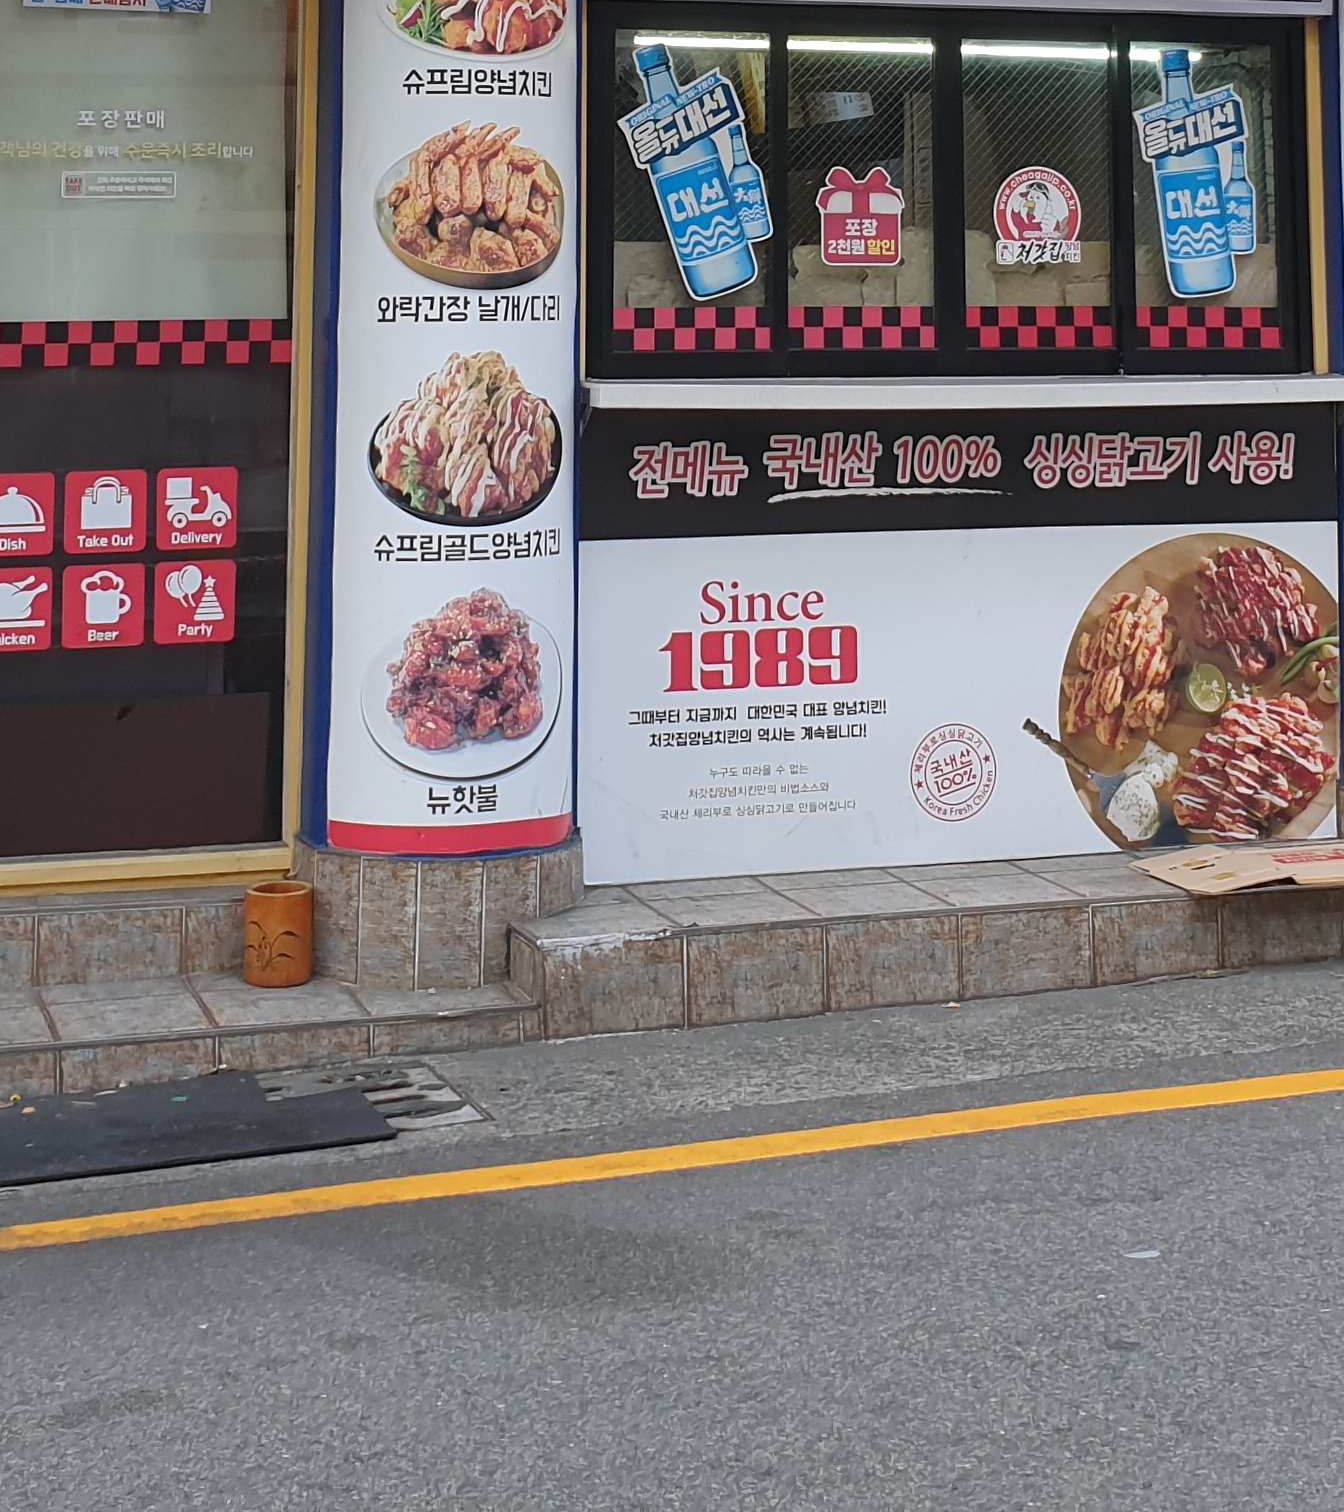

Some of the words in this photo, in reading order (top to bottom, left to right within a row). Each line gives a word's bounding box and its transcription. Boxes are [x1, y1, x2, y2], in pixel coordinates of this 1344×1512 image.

[402, 68, 552, 98] 슈프림양념치킨
[630, 96, 670, 126] ORIGINAL
[632, 86, 731, 163] 올뉴대선
[1144, 100, 1237, 157] 올뉴대선
[667, 178, 729, 222] 대선
[1165, 185, 1221, 220] 대선
[845, 218, 878, 237] 포장
[828, 239, 865, 256] 2천원
[866, 239, 896, 256] 할인
[1016, 240, 1063, 262] 처갓집
[376, 296, 471, 323] 와락간장
[477, 295, 560, 324] 날개/다리
[628, 441, 749, 499] 전메뉴
[762, 433, 881, 489] 국내산
[891, 435, 1002, 486] 100%
[1024, 433, 1202, 489] 싱싱닭고기
[1207, 432, 1296, 486] 사용!
[77, 534, 108, 548] Take
[112, 533, 134, 547] Out
[171, 532, 222, 545] Delivery
[373, 528, 560, 562] 슈프림골드양념치킨
[699, 580, 824, 624] Since
[88, 629, 119, 643] Beer
[178, 623, 213, 637] Party
[658, 625, 859, 693] 1989
[628, 709, 680, 725] 그때부터
[686, 706, 737, 723] 지금까지
[747, 703, 798, 720] 대한민국
[803, 702, 828, 717] 대표
[833, 699, 887, 716] 양념치킨!
[648, 728, 752, 748] 처갓집양념치킨의
[757, 726, 795, 743] 역사는
[801, 723, 867, 741] 계속됩니다!
[709, 766, 738, 779] 누구도
[775, 764, 785, 775] 수
[930, 748, 972, 774] 국내산
[923, 796, 948, 815] Korea
[949, 804, 973, 816] Fresh
[972, 770, 993, 806] Chicken
[934, 768, 977, 793] 100%
[426, 785, 498, 815] 뉴핫불
[659, 808, 689, 821] 국내산
